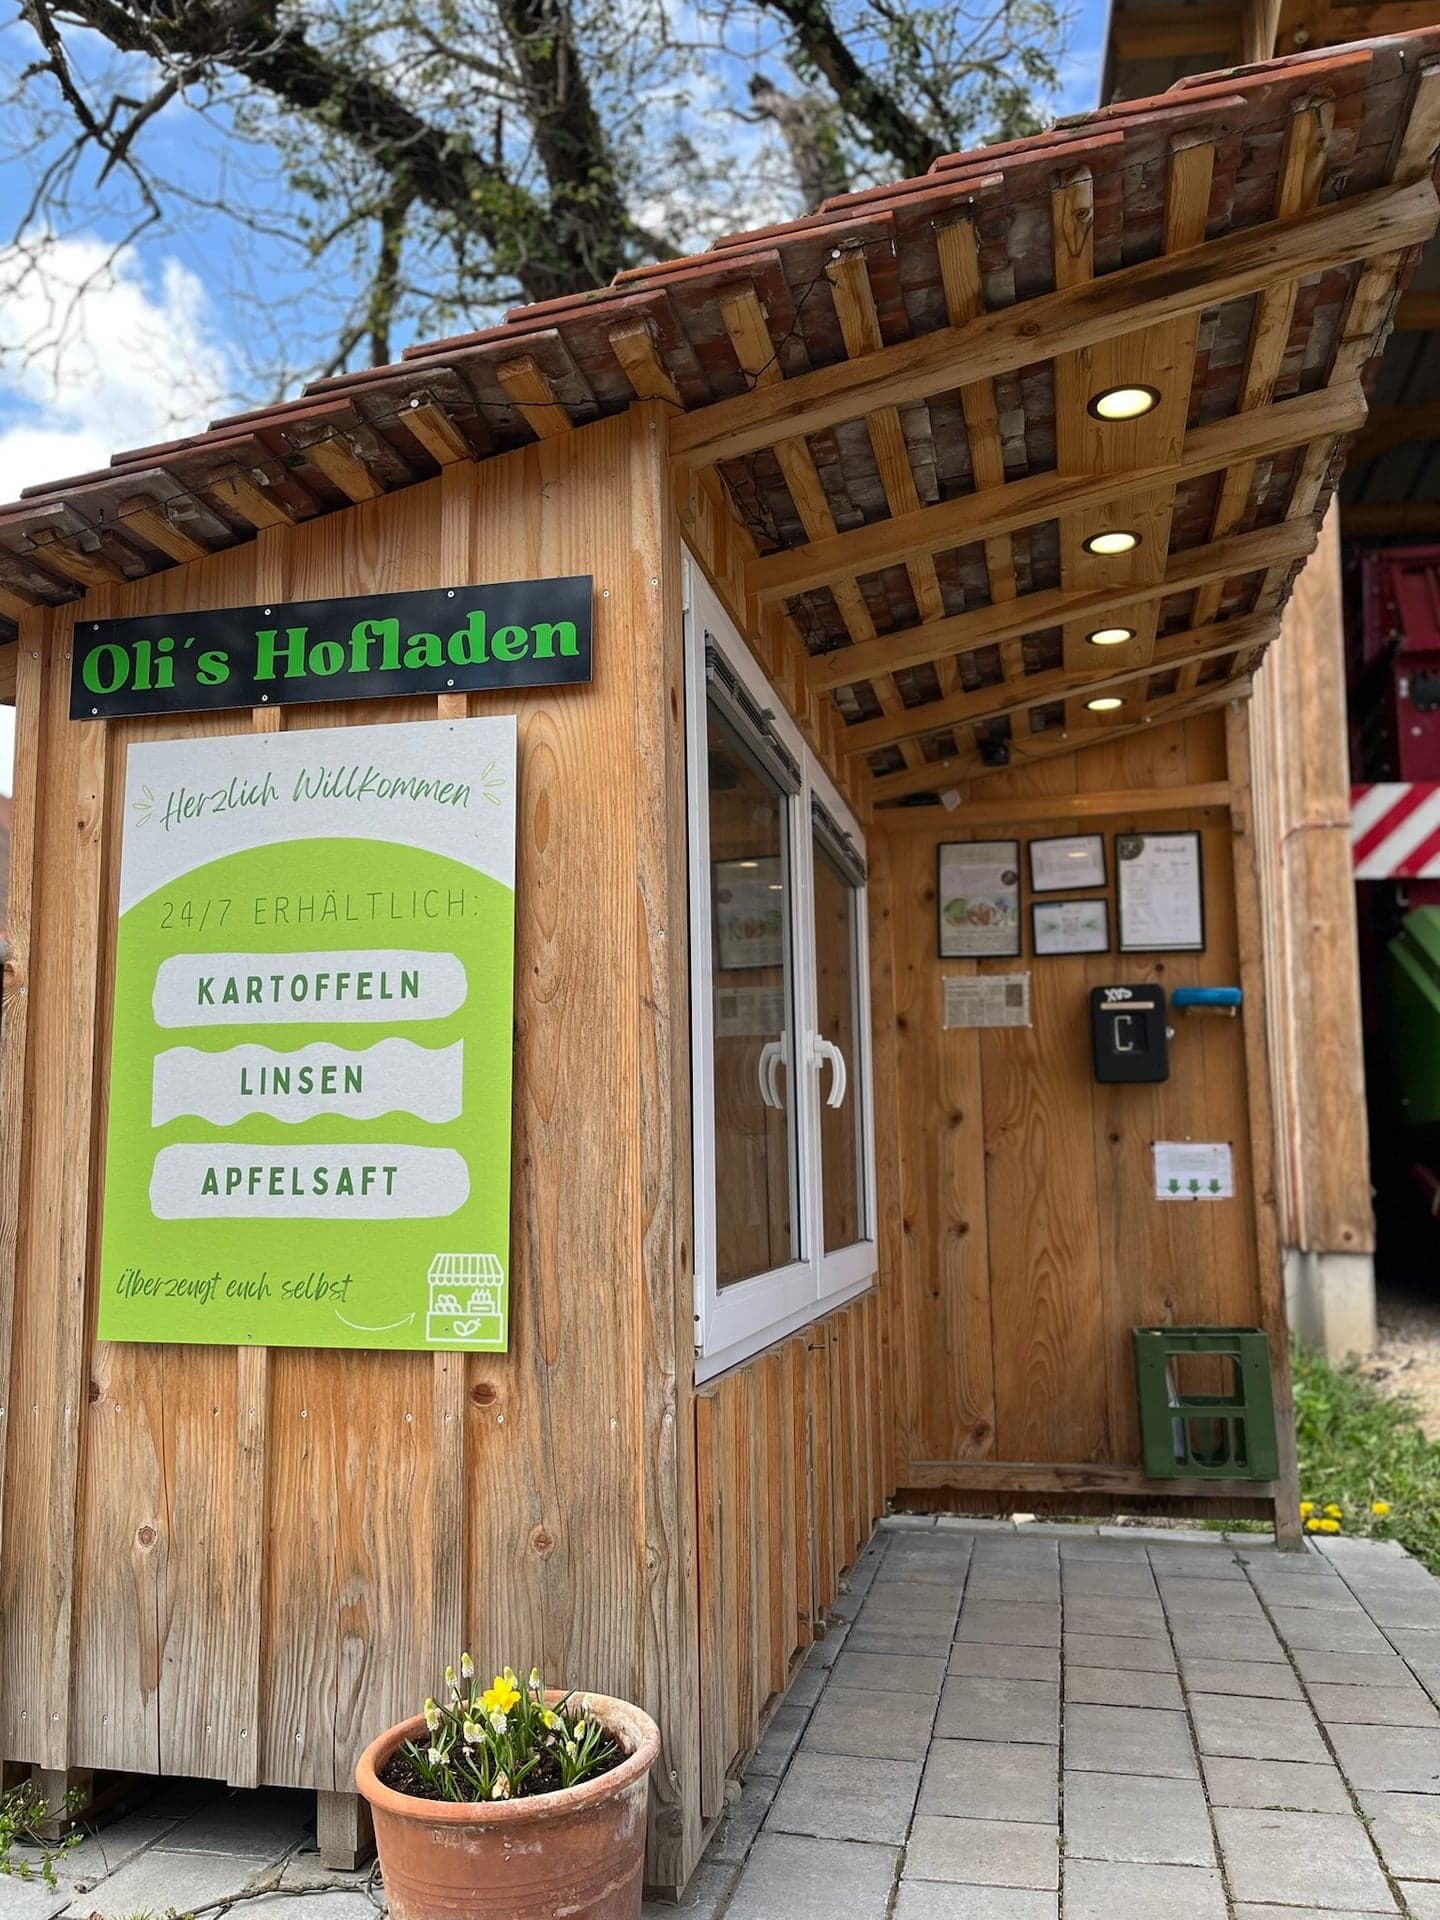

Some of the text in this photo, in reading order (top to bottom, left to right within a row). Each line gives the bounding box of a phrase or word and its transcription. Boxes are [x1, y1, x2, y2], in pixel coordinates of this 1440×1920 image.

[253, 610, 580, 682] Hofladen
[160, 766, 472, 831] Herzlich Willkommen
[160, 888, 480, 933] 24/7 ERHÄLTLICH:
[197, 970, 420, 1006] KARTOFFELN
[240, 1065, 364, 1096] LINSEN
[200, 1166, 399, 1196] APFELSAFT
[225, 1273, 271, 1300] euch
[281, 1272, 353, 1303] selbst
